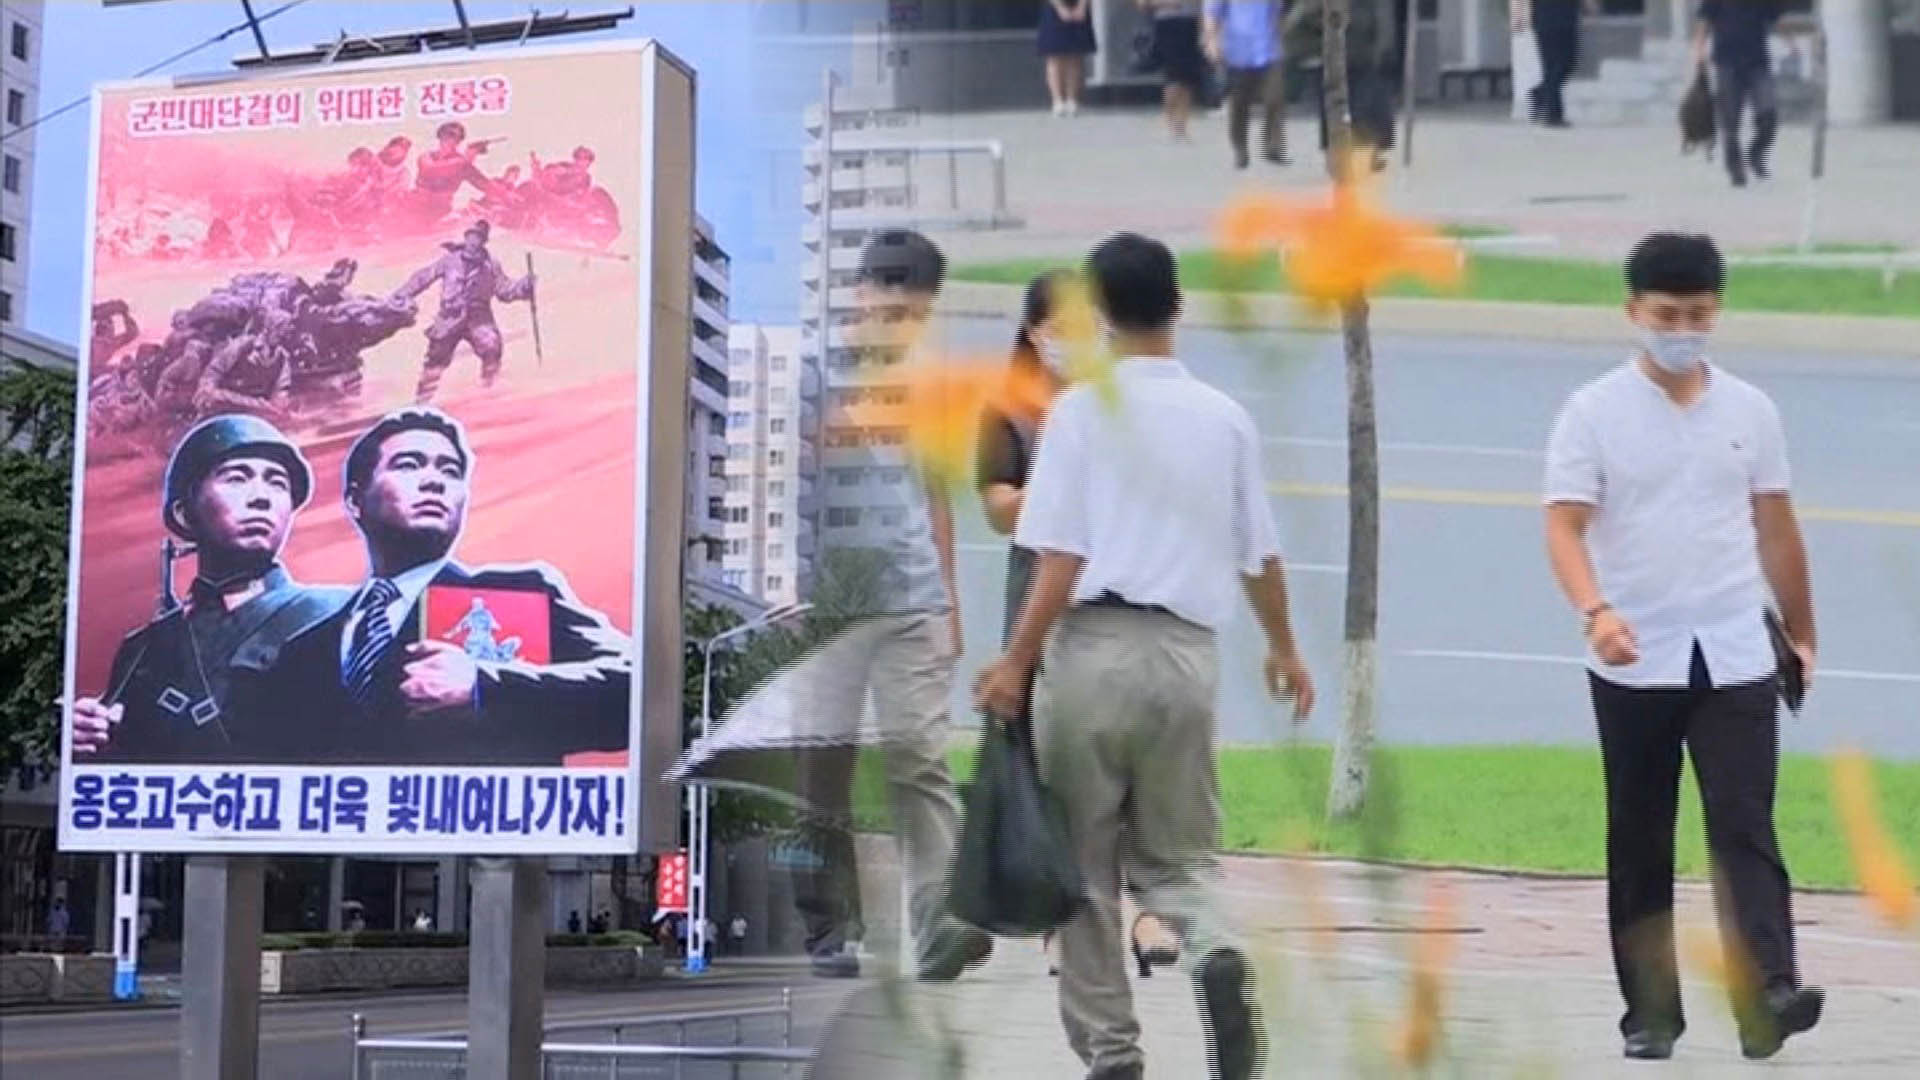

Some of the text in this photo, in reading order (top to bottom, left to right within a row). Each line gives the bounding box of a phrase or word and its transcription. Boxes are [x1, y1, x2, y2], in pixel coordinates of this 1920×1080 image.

[131, 93, 301, 132] 군민대단결의
[318, 86, 404, 121] 위대한
[72, 772, 625, 836] 옹호고수하고 더욱 빛내여나가자!
